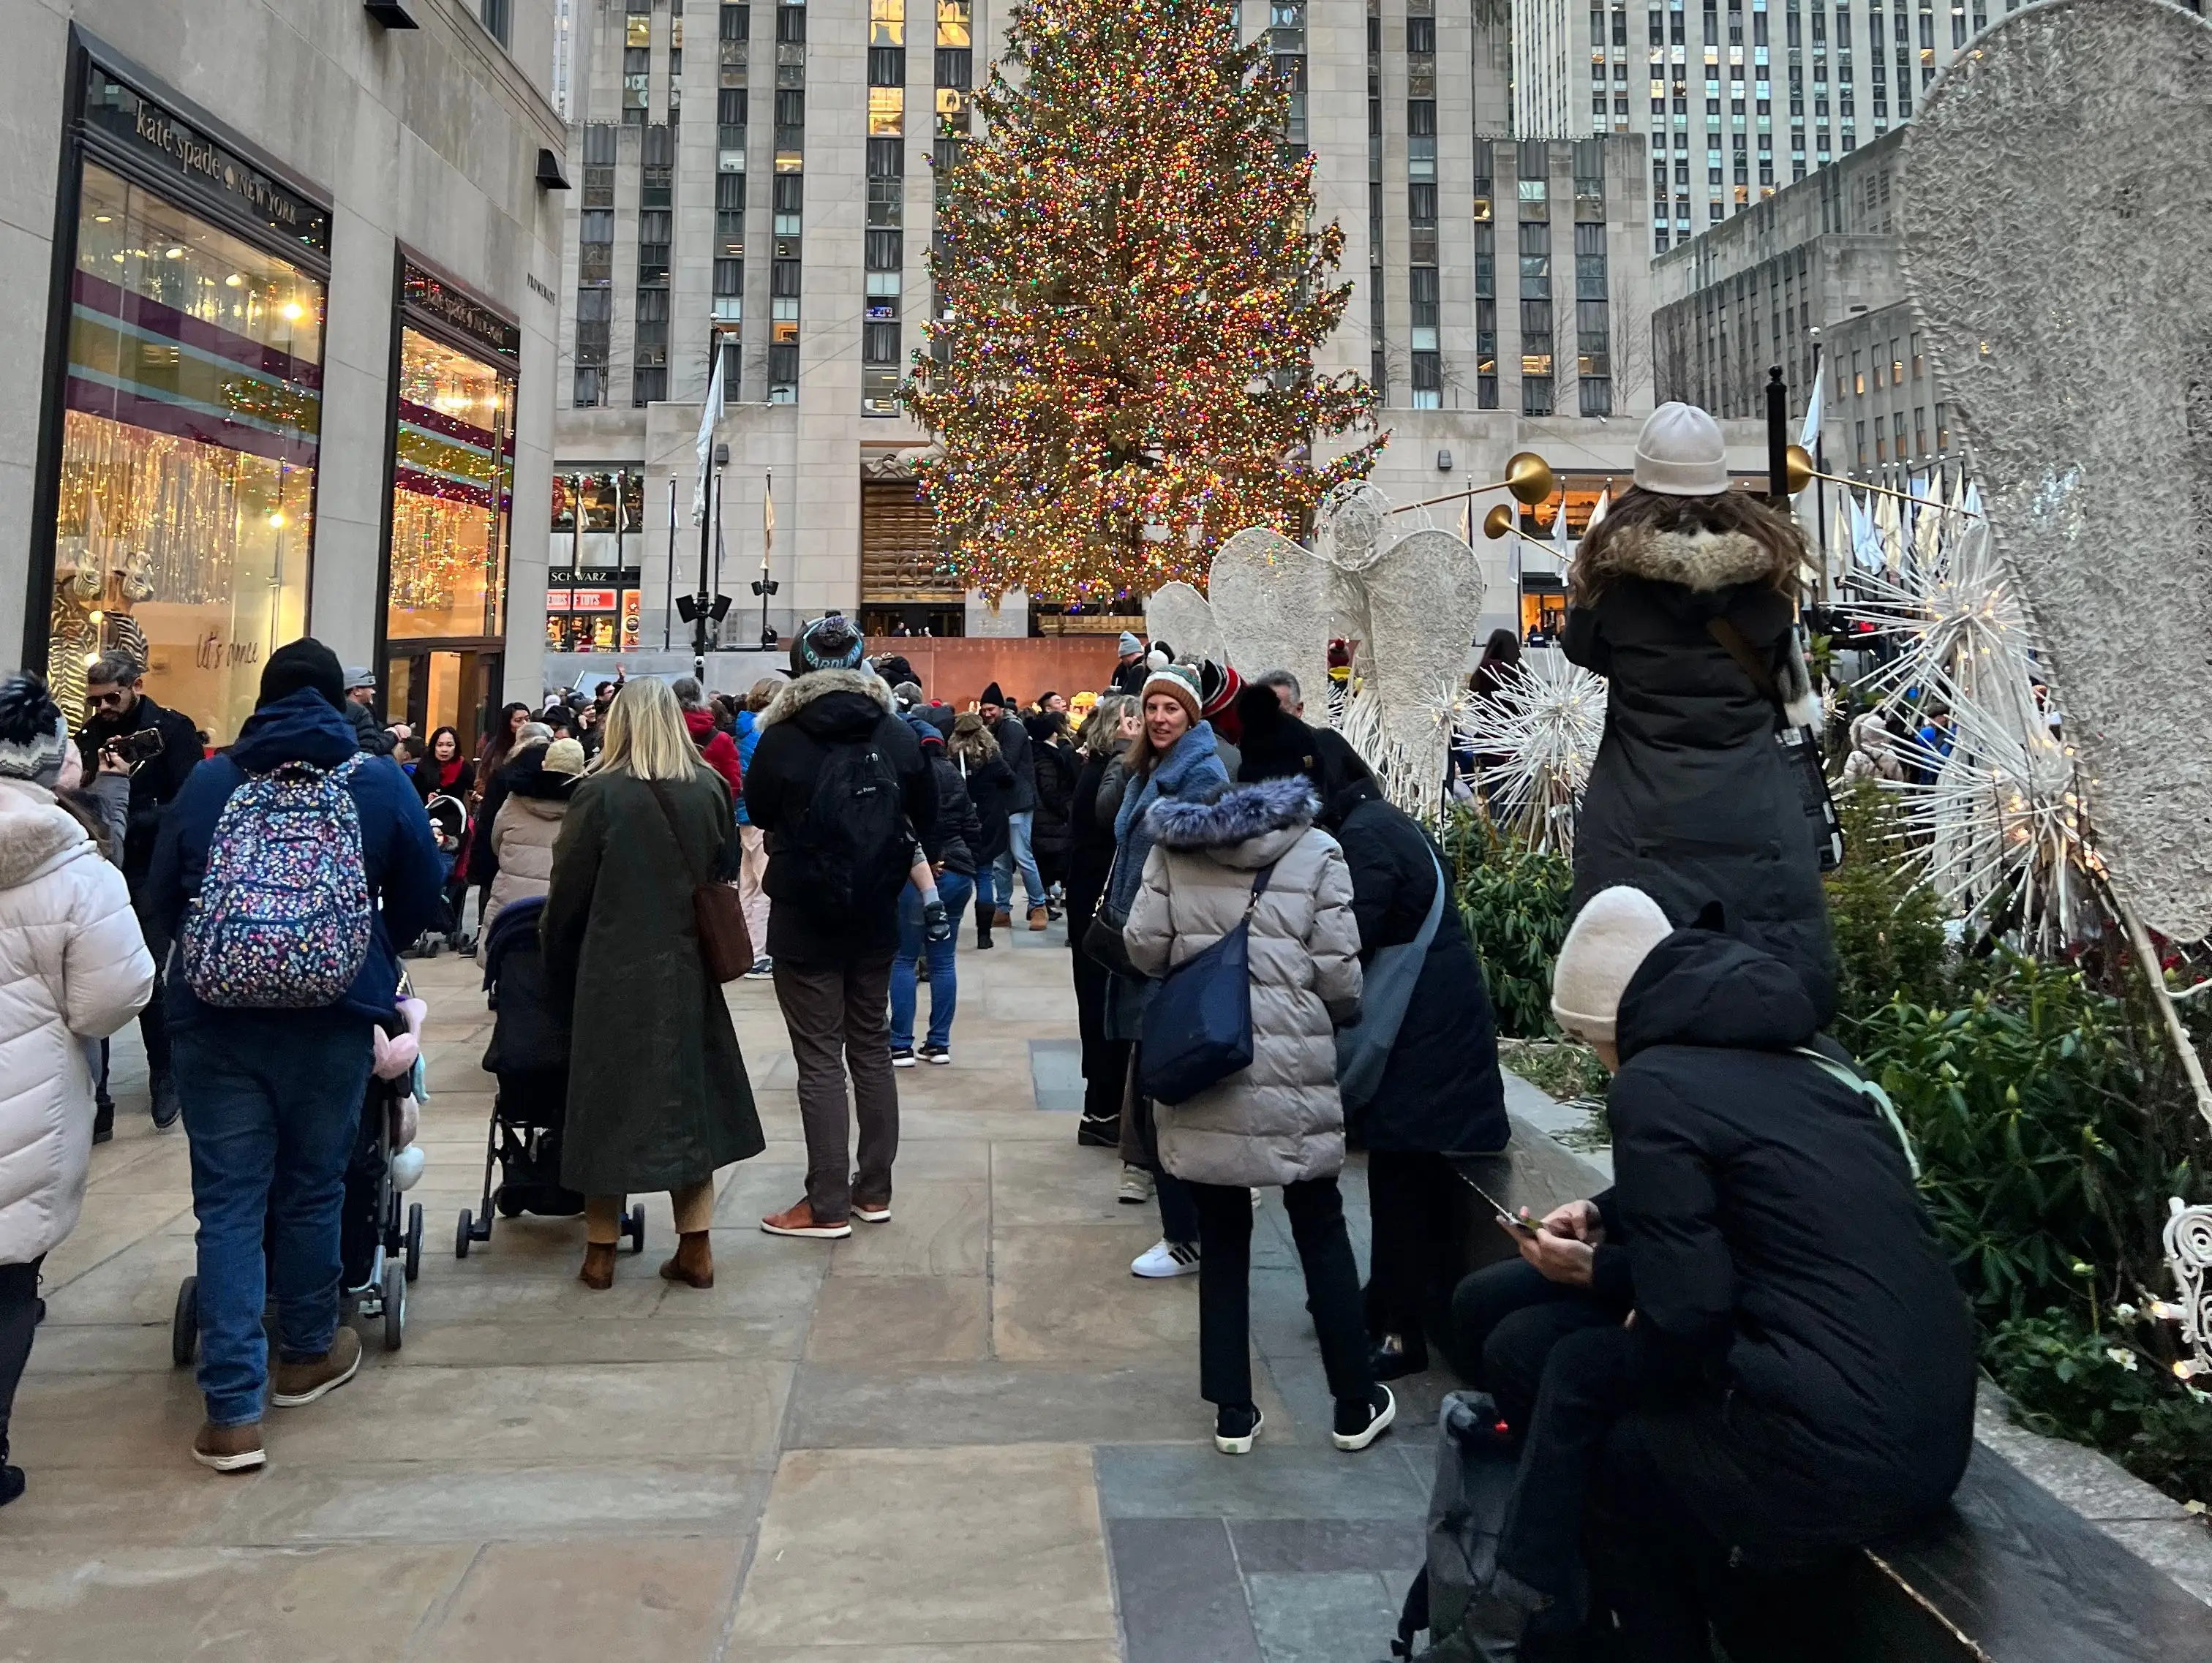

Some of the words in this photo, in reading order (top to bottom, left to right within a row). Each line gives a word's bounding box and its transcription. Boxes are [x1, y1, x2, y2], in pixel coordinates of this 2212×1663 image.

[136, 99, 172, 152] kate
[176, 136, 220, 179] spade
[238, 173, 266, 206] NEW
[267, 189, 296, 225] YORK
